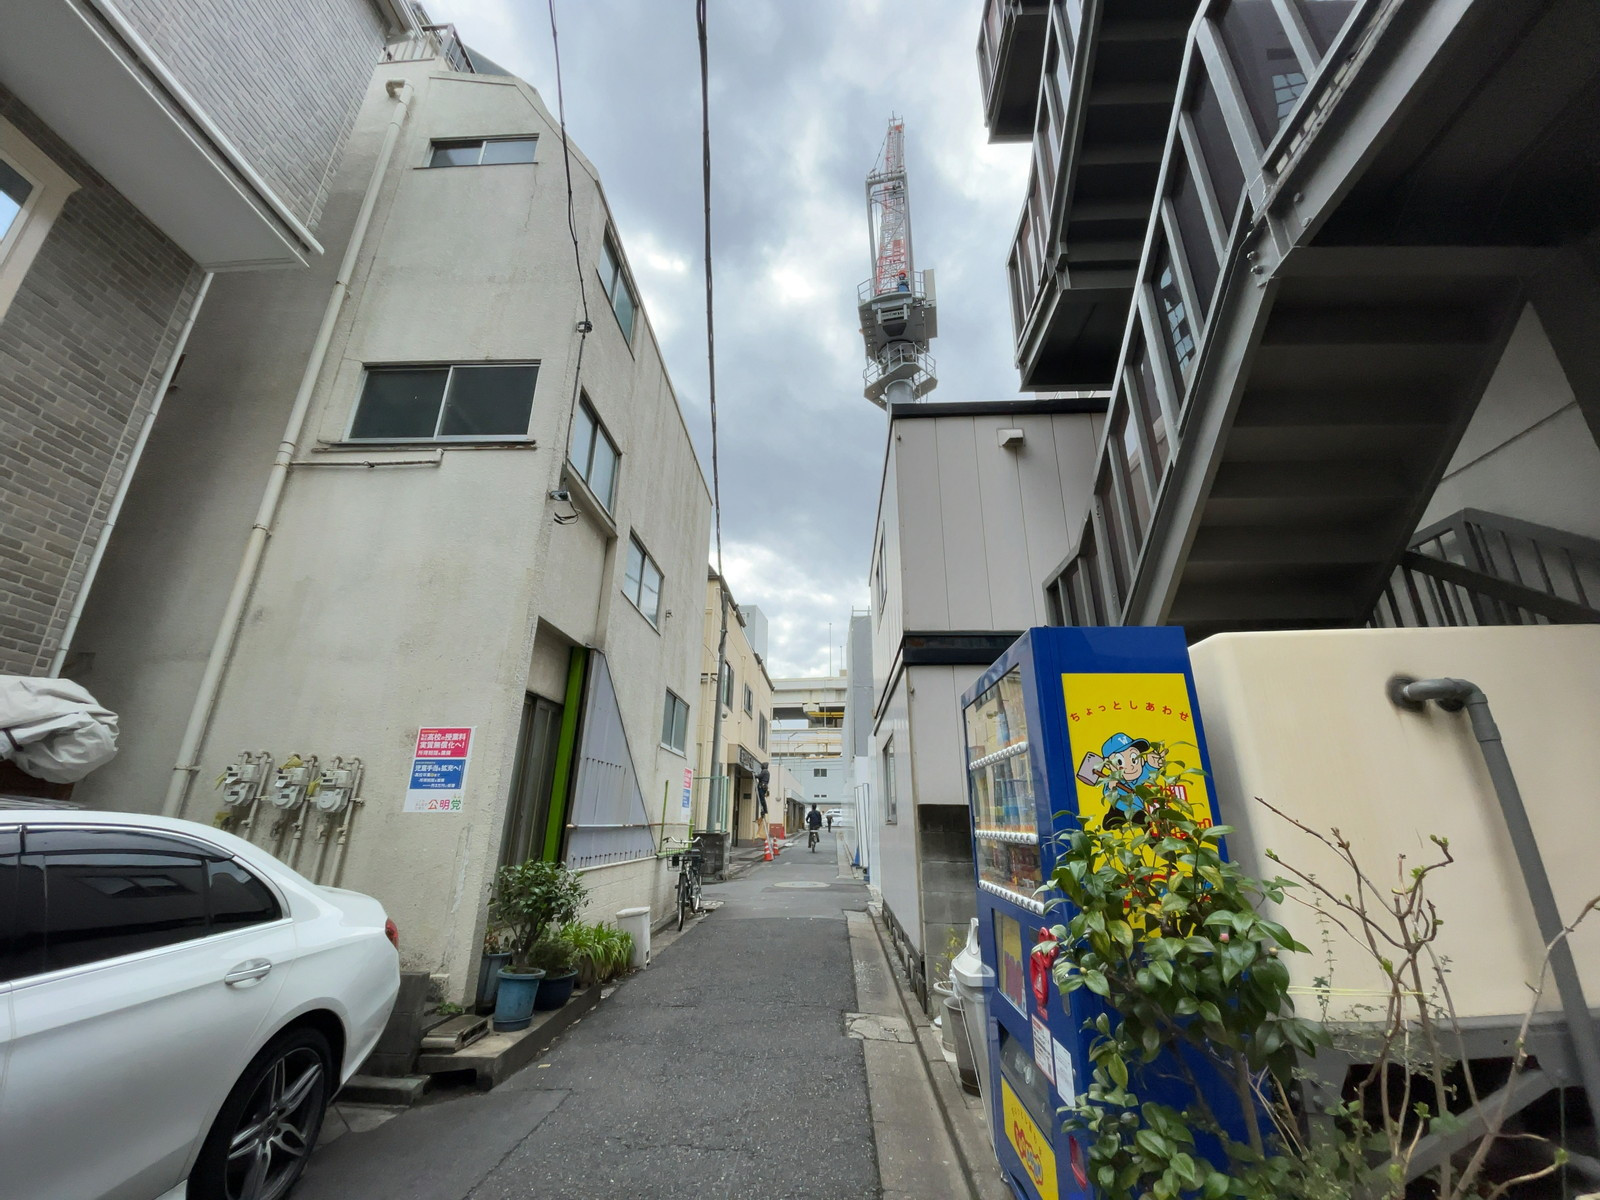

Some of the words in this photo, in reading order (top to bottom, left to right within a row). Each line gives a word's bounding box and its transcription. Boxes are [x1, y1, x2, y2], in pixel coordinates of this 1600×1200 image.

[1070, 700, 1189, 721] ちょっとしあわせ
[1117, 736, 1128, 745] W
[428, 799, 461, 810] 公明党
